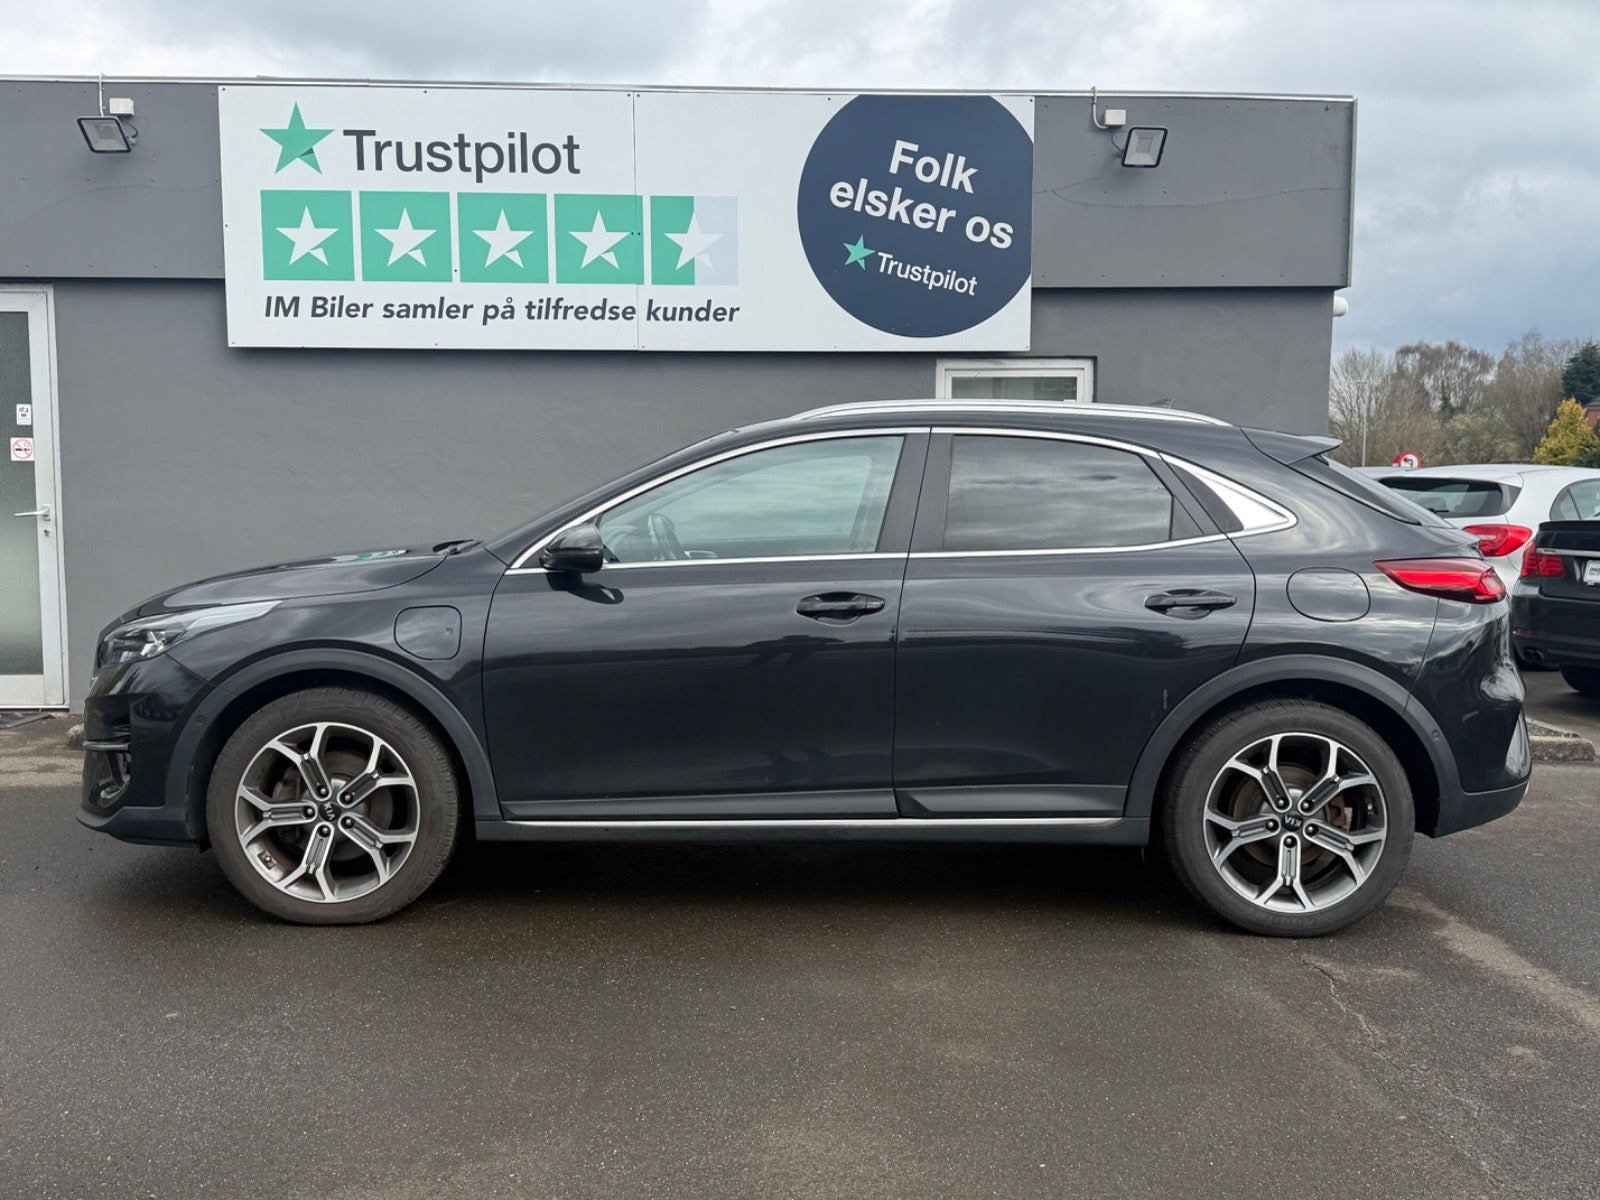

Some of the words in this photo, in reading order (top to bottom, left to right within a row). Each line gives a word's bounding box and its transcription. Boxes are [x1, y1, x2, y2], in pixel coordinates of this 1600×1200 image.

[342, 129, 581, 184] Trustpilot
[889, 139, 979, 194] Folk
[829, 177, 957, 233] elsker
[965, 215, 1015, 249] os
[877, 251, 978, 296] Trustpilot
[264, 295, 301, 318] IM
[310, 295, 374, 319] Biler
[382, 299, 475, 320] samler
[482, 296, 516, 326] på
[524, 297, 637, 321] tilfredse
[645, 298, 741, 323] kunder
